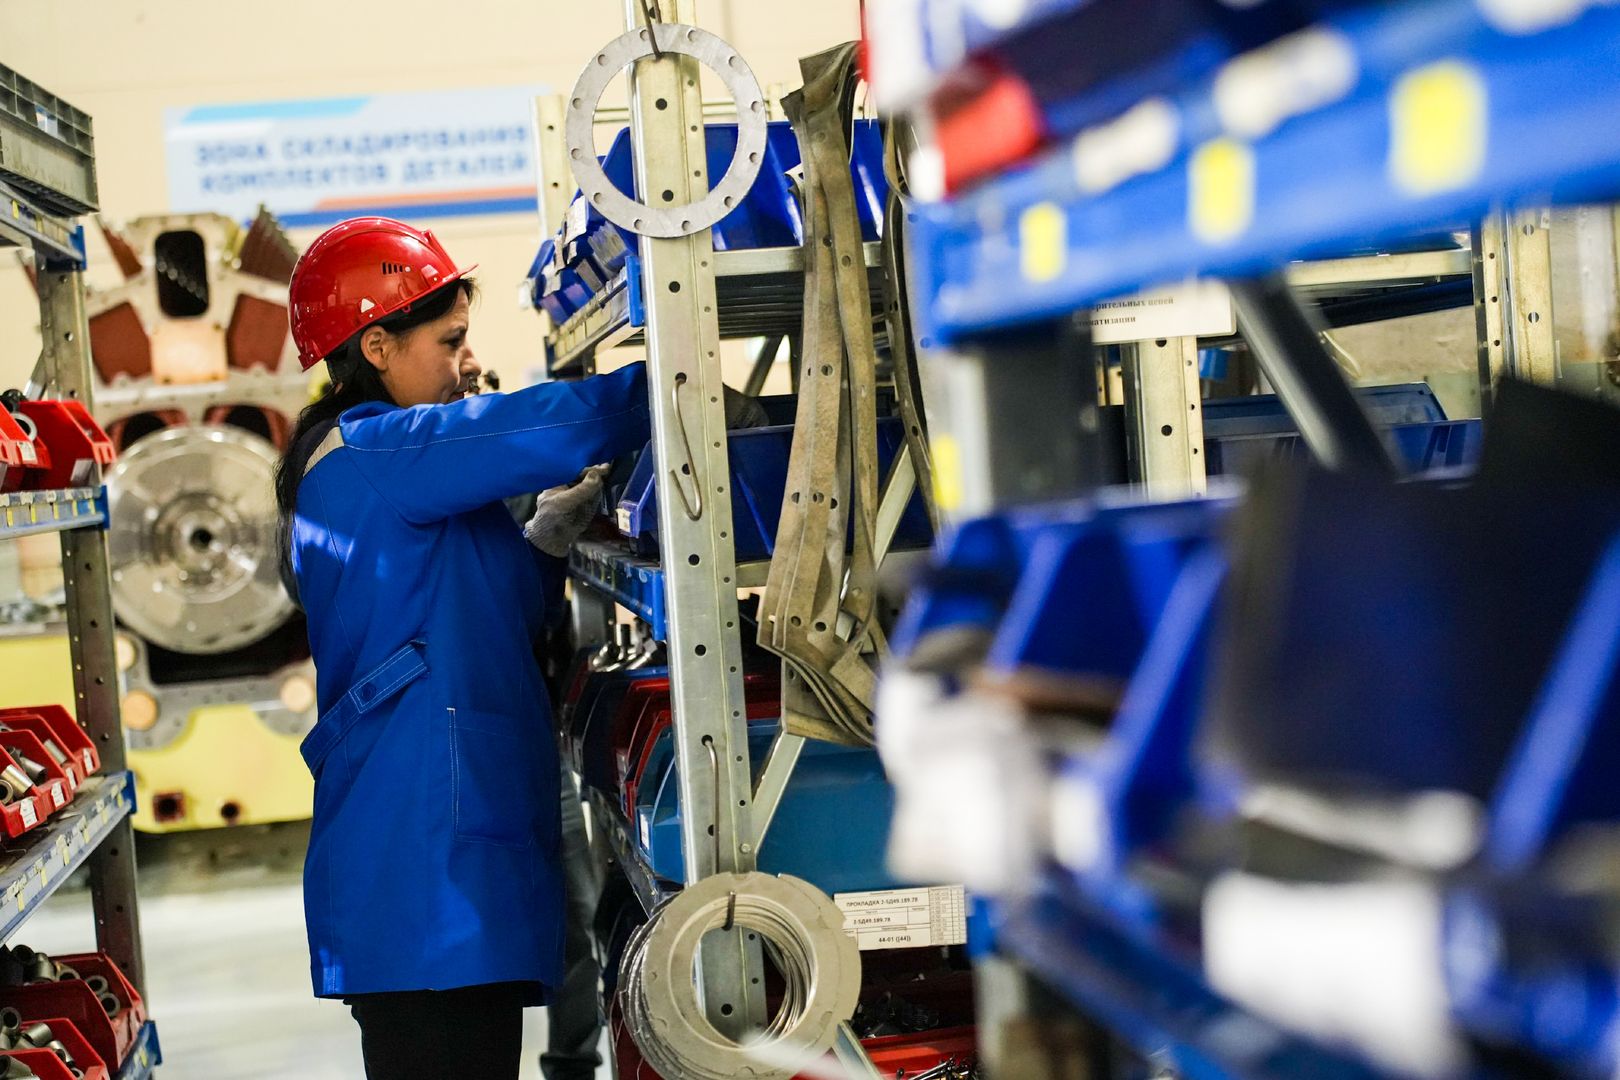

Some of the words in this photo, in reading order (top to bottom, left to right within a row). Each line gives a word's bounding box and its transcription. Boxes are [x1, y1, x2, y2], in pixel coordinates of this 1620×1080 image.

[200, 164, 387, 193] КОМПЛЕКТОВ
[403, 154, 526, 183] ДЕТАЛЕЙ
[1095, 299, 1146, 311] рительных
